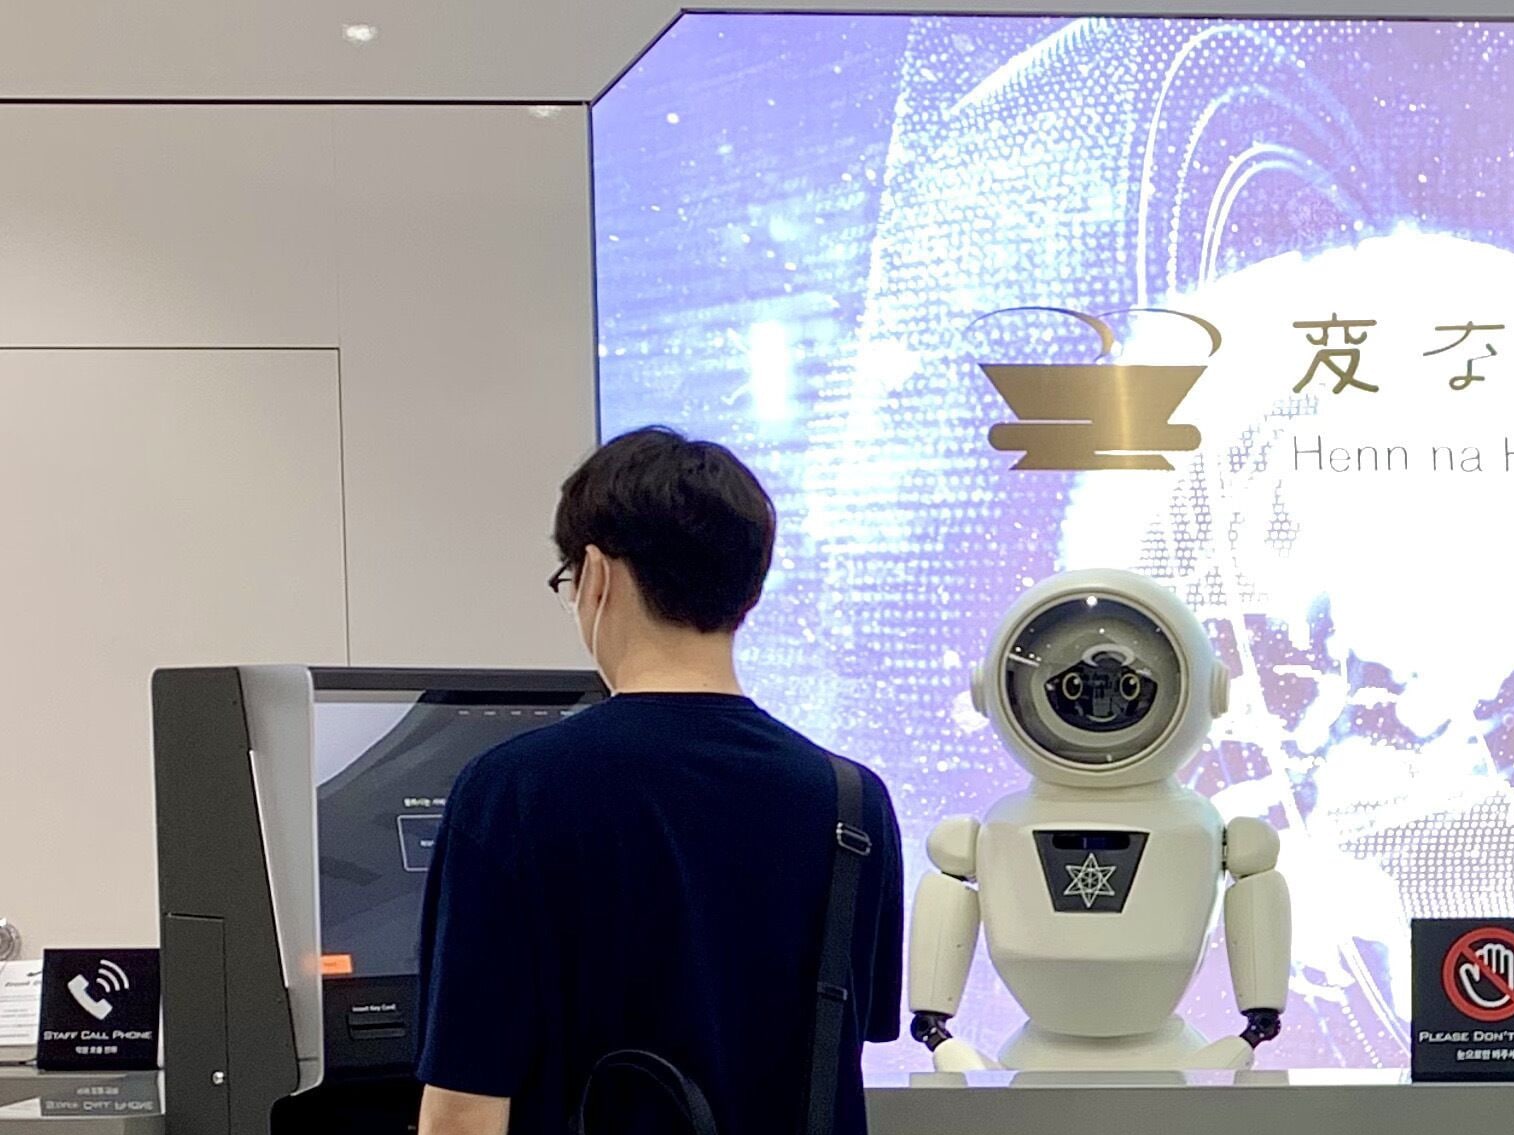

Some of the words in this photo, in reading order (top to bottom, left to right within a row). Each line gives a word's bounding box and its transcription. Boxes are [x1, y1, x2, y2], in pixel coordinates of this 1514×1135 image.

[1293, 435, 1409, 472] Henn
[1431, 445, 1483, 473] na
[43, 1030, 78, 1041] STAFF
[81, 1030, 109, 1040] CALL
[112, 1030, 153, 1040] PHONE
[1418, 1031, 1470, 1043] PLEASE
